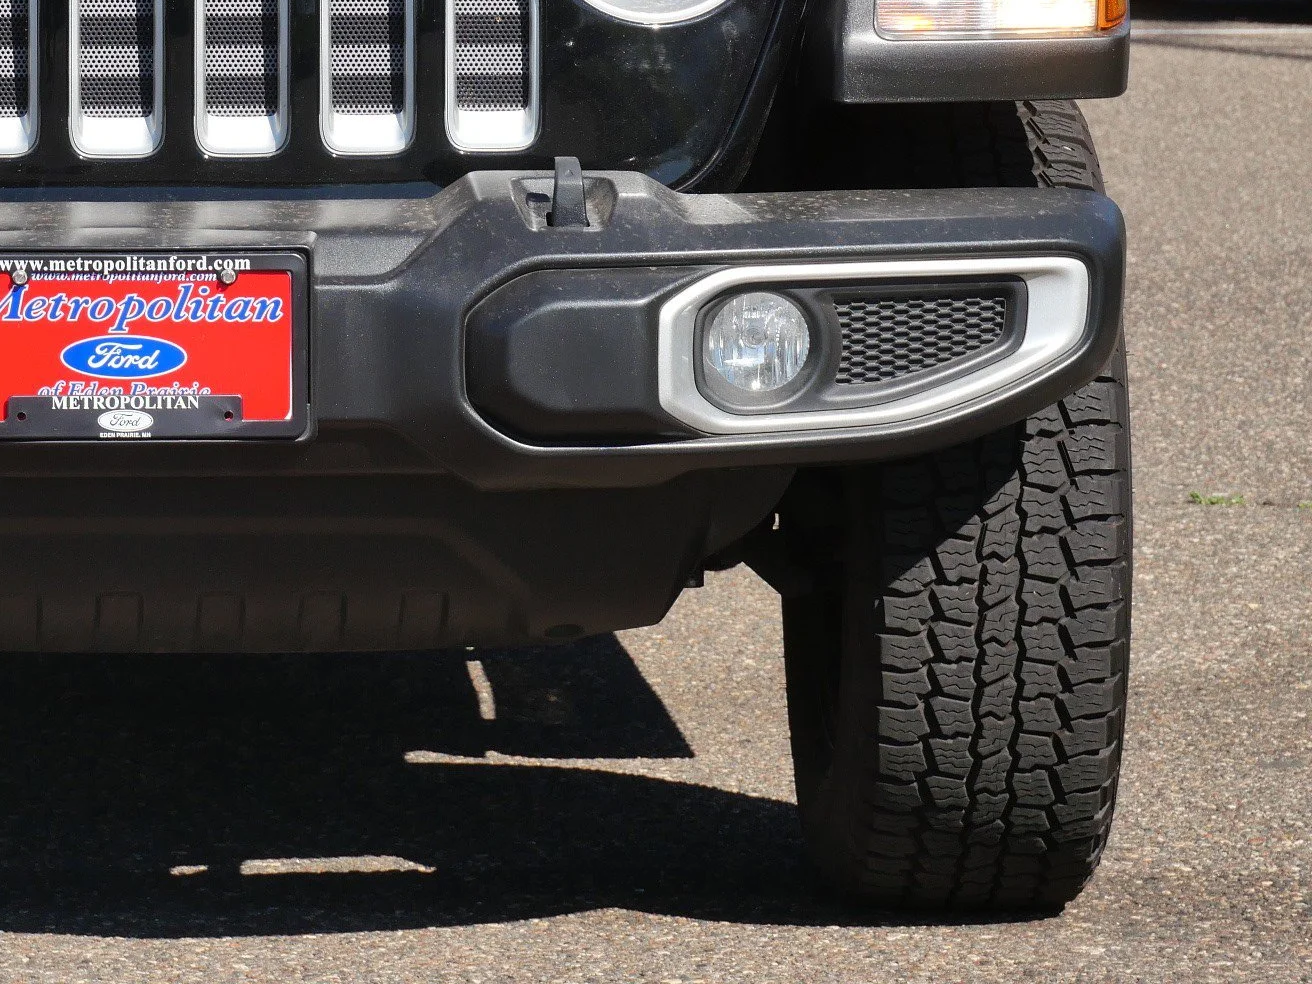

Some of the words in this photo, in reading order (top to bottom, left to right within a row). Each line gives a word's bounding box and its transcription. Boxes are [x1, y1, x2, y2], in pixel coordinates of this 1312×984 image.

[87, 341, 159, 371] Ford
[67, 380, 124, 396] Eden
[129, 380, 211, 396] Prairie
[51, 395, 200, 410] METROPOLITAN
[109, 413, 142, 427] Ford
